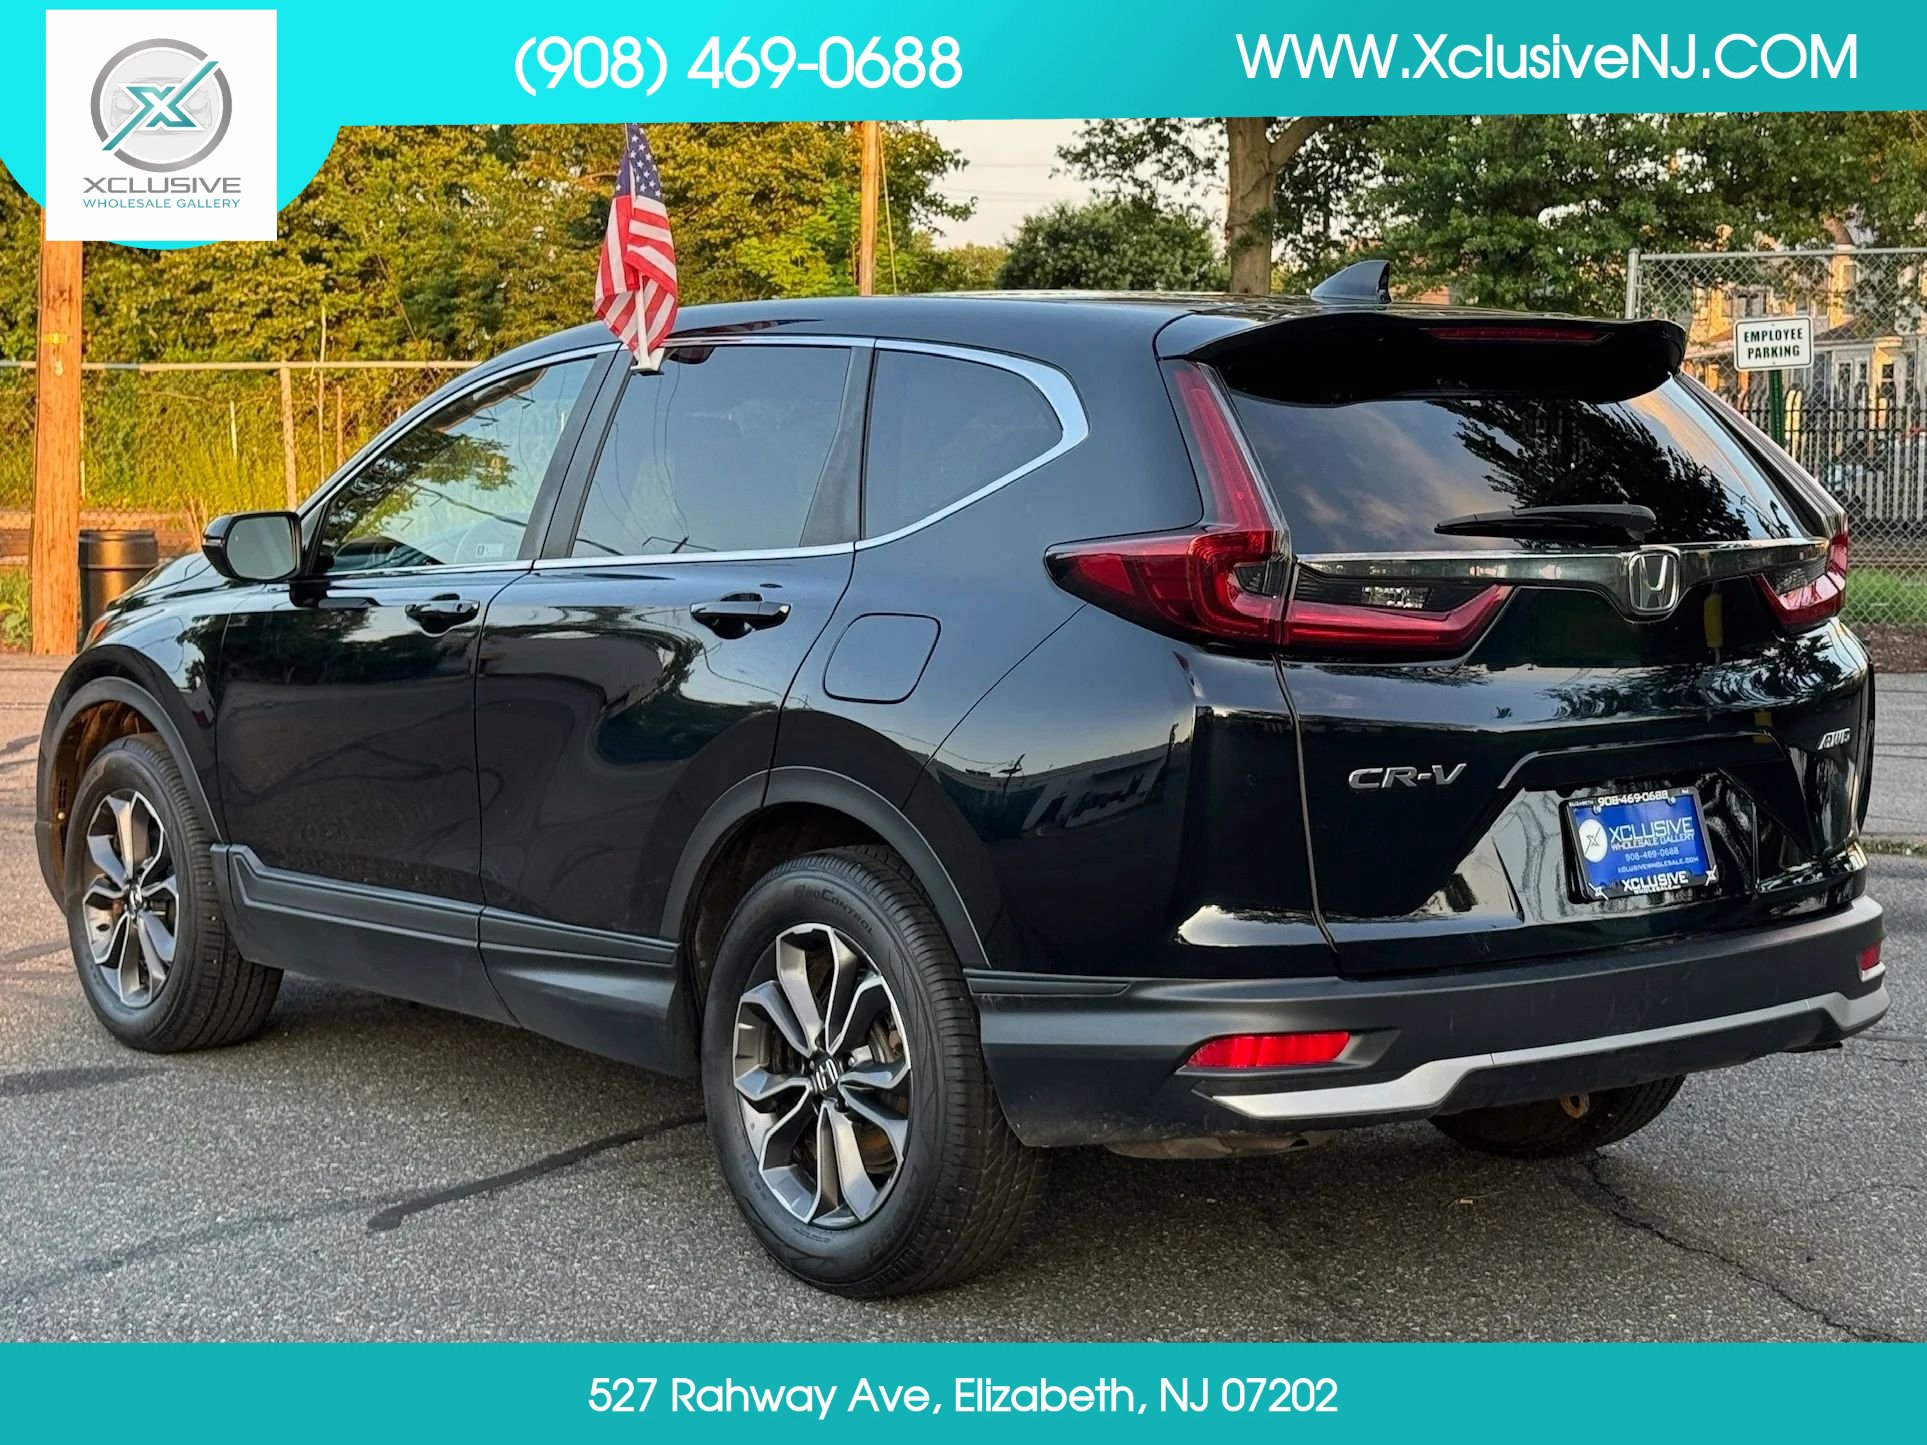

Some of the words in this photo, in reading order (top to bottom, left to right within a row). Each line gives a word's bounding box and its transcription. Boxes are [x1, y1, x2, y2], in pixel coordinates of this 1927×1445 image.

[1744, 328, 1803, 343] EMPLOYEE
[1748, 345, 1800, 359] PARKING
[1348, 763, 1467, 789] CR-V
[1598, 790, 1669, 807] 908-469-0688
[1609, 816, 1695, 843] XCLUSIVE
[1611, 837, 1659, 852] WHOLESALE
[1660, 832, 1695, 845] GALLERY
[1625, 847, 1680, 862] 908-469-0688
[1621, 870, 1689, 892] XCLUSIVE
